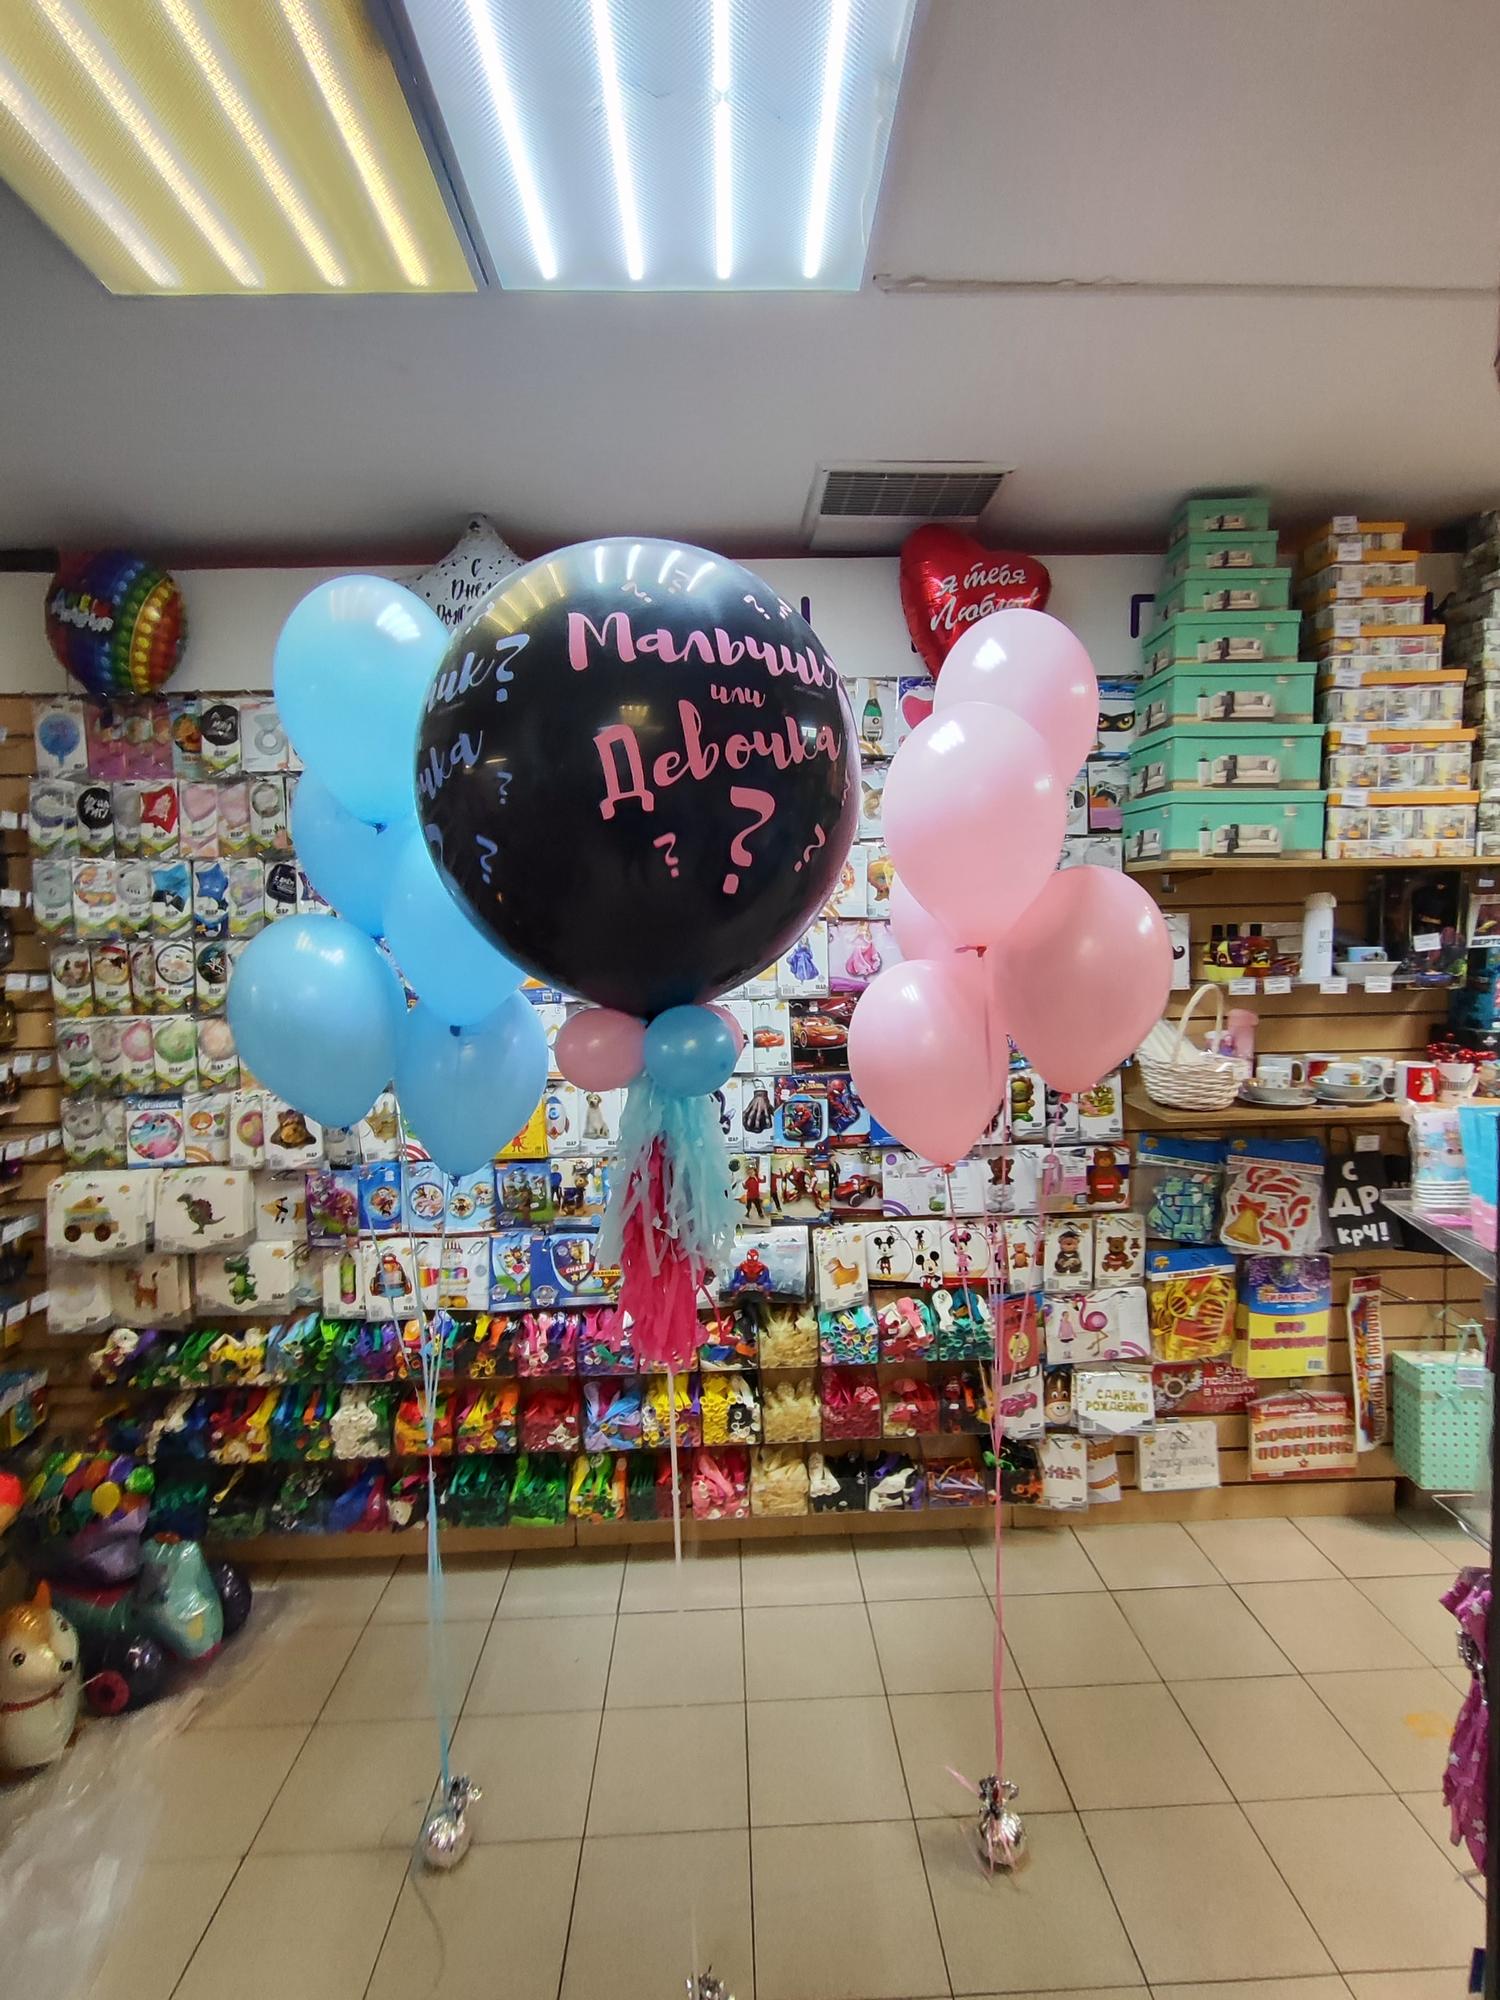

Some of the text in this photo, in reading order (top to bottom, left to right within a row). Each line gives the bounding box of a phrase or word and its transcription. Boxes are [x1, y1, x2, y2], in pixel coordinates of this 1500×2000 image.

[963, 562, 1027, 589] тебя
[710, 682, 767, 709] или
[592, 699, 843, 821] Девочка
[1328, 1185, 1379, 1218] ДР
